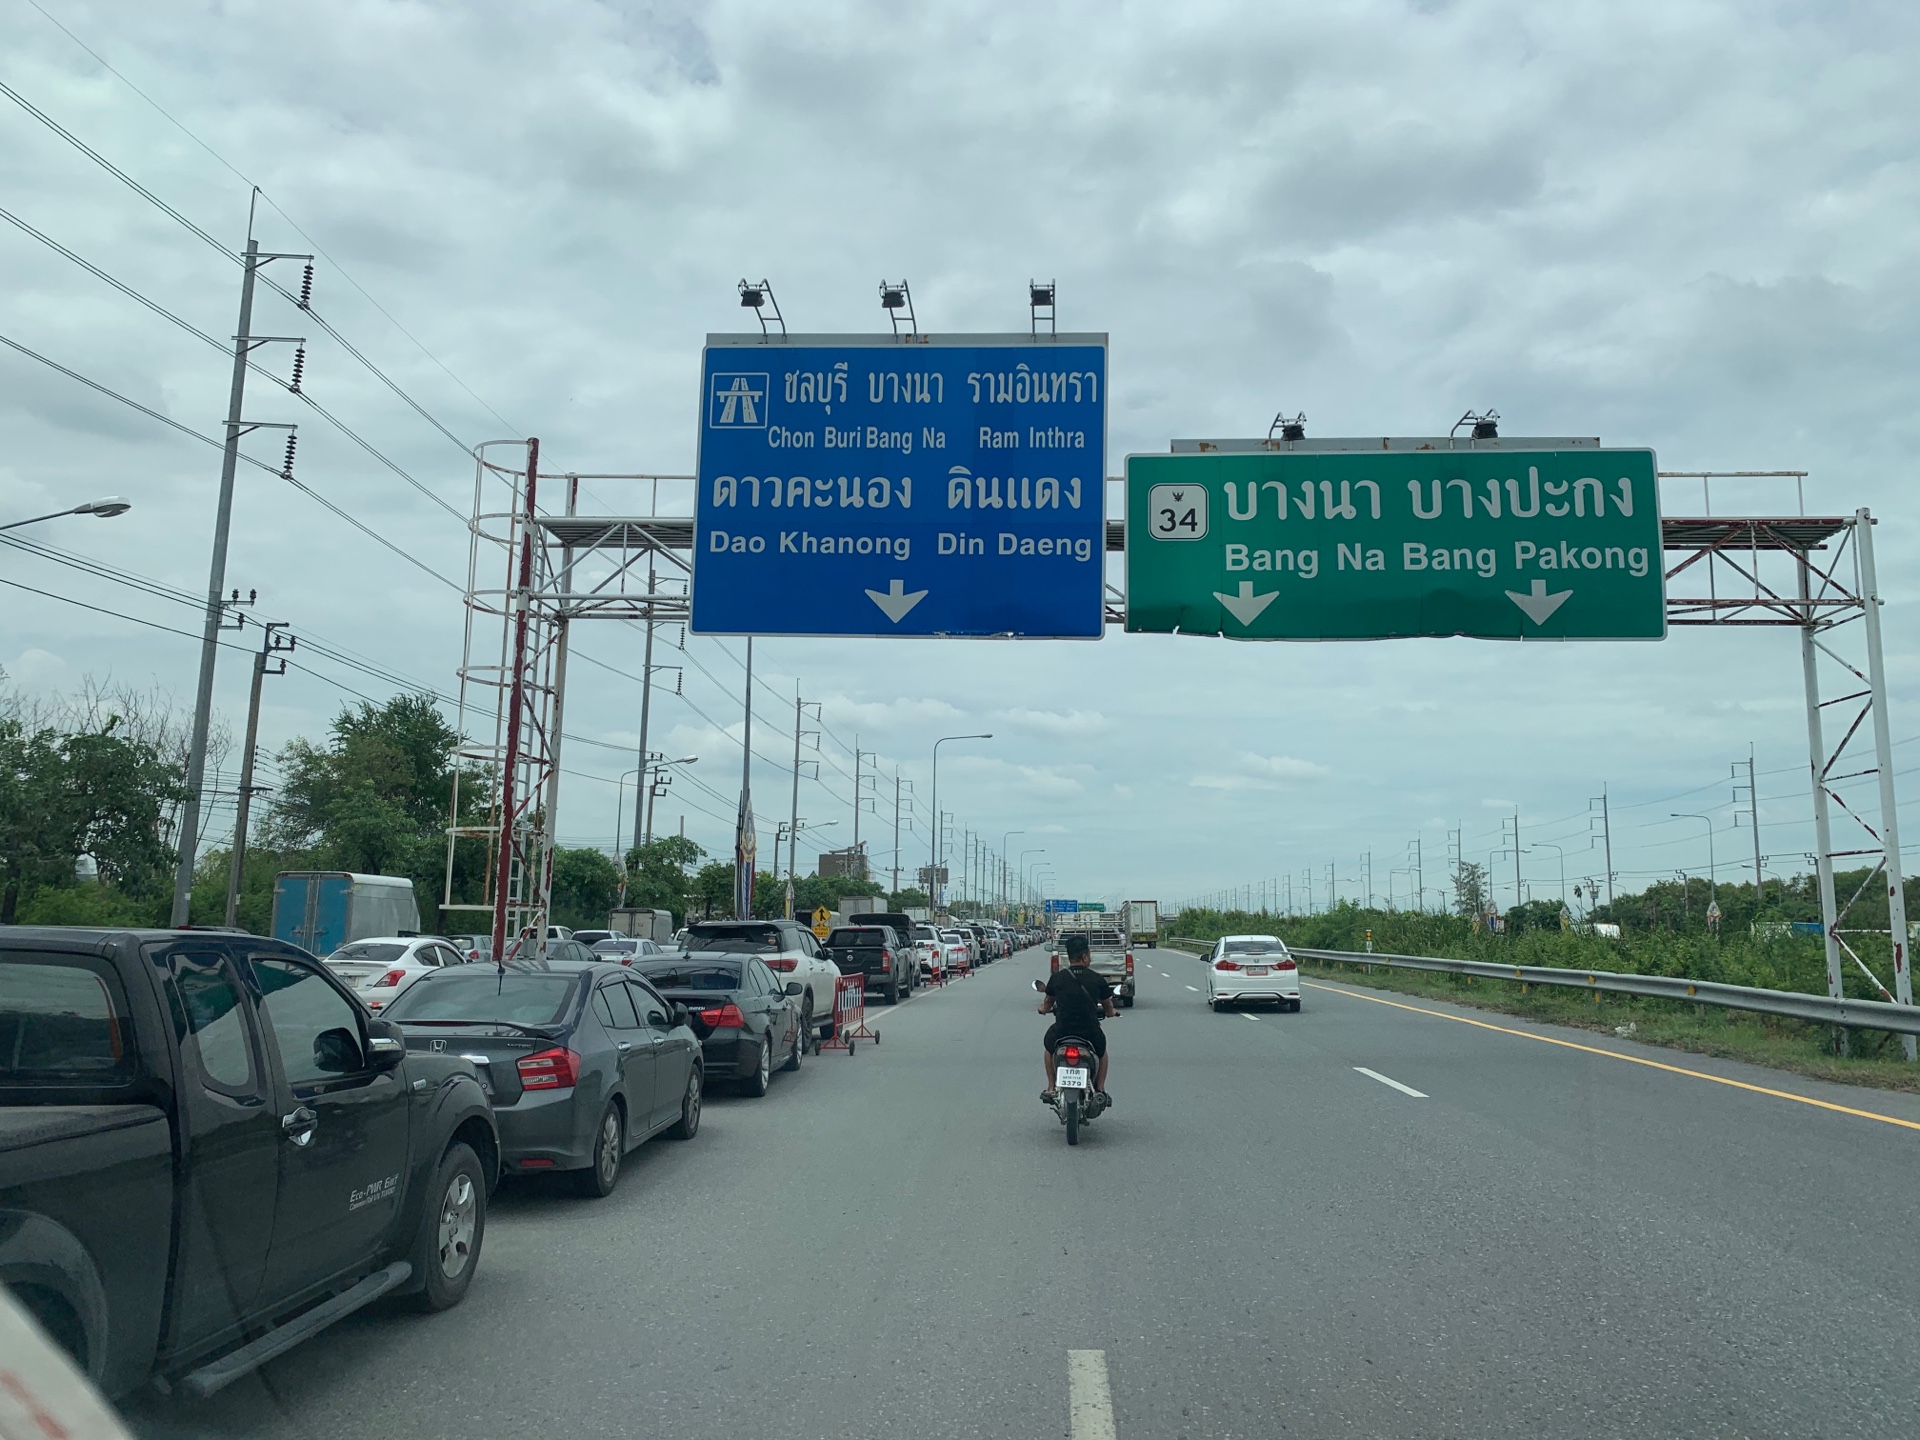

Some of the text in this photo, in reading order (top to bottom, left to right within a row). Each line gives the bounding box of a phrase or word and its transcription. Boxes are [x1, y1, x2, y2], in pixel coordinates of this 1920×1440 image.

[786, 362, 1098, 414] ชลบุรี บางนา รามอินทรา
[768, 426, 1085, 454] Chon Buri Bang Na Ram Inthra
[713, 465, 1082, 510] ดาวคะนอง ดินแดง
[1223, 466, 1634, 521] บางนา บางปะกง
[1158, 508, 1199, 534] 34
[710, 530, 1092, 562] Dao Khanong Din Daeng
[1225, 540, 1649, 579] Bang Na Bang Pakong
